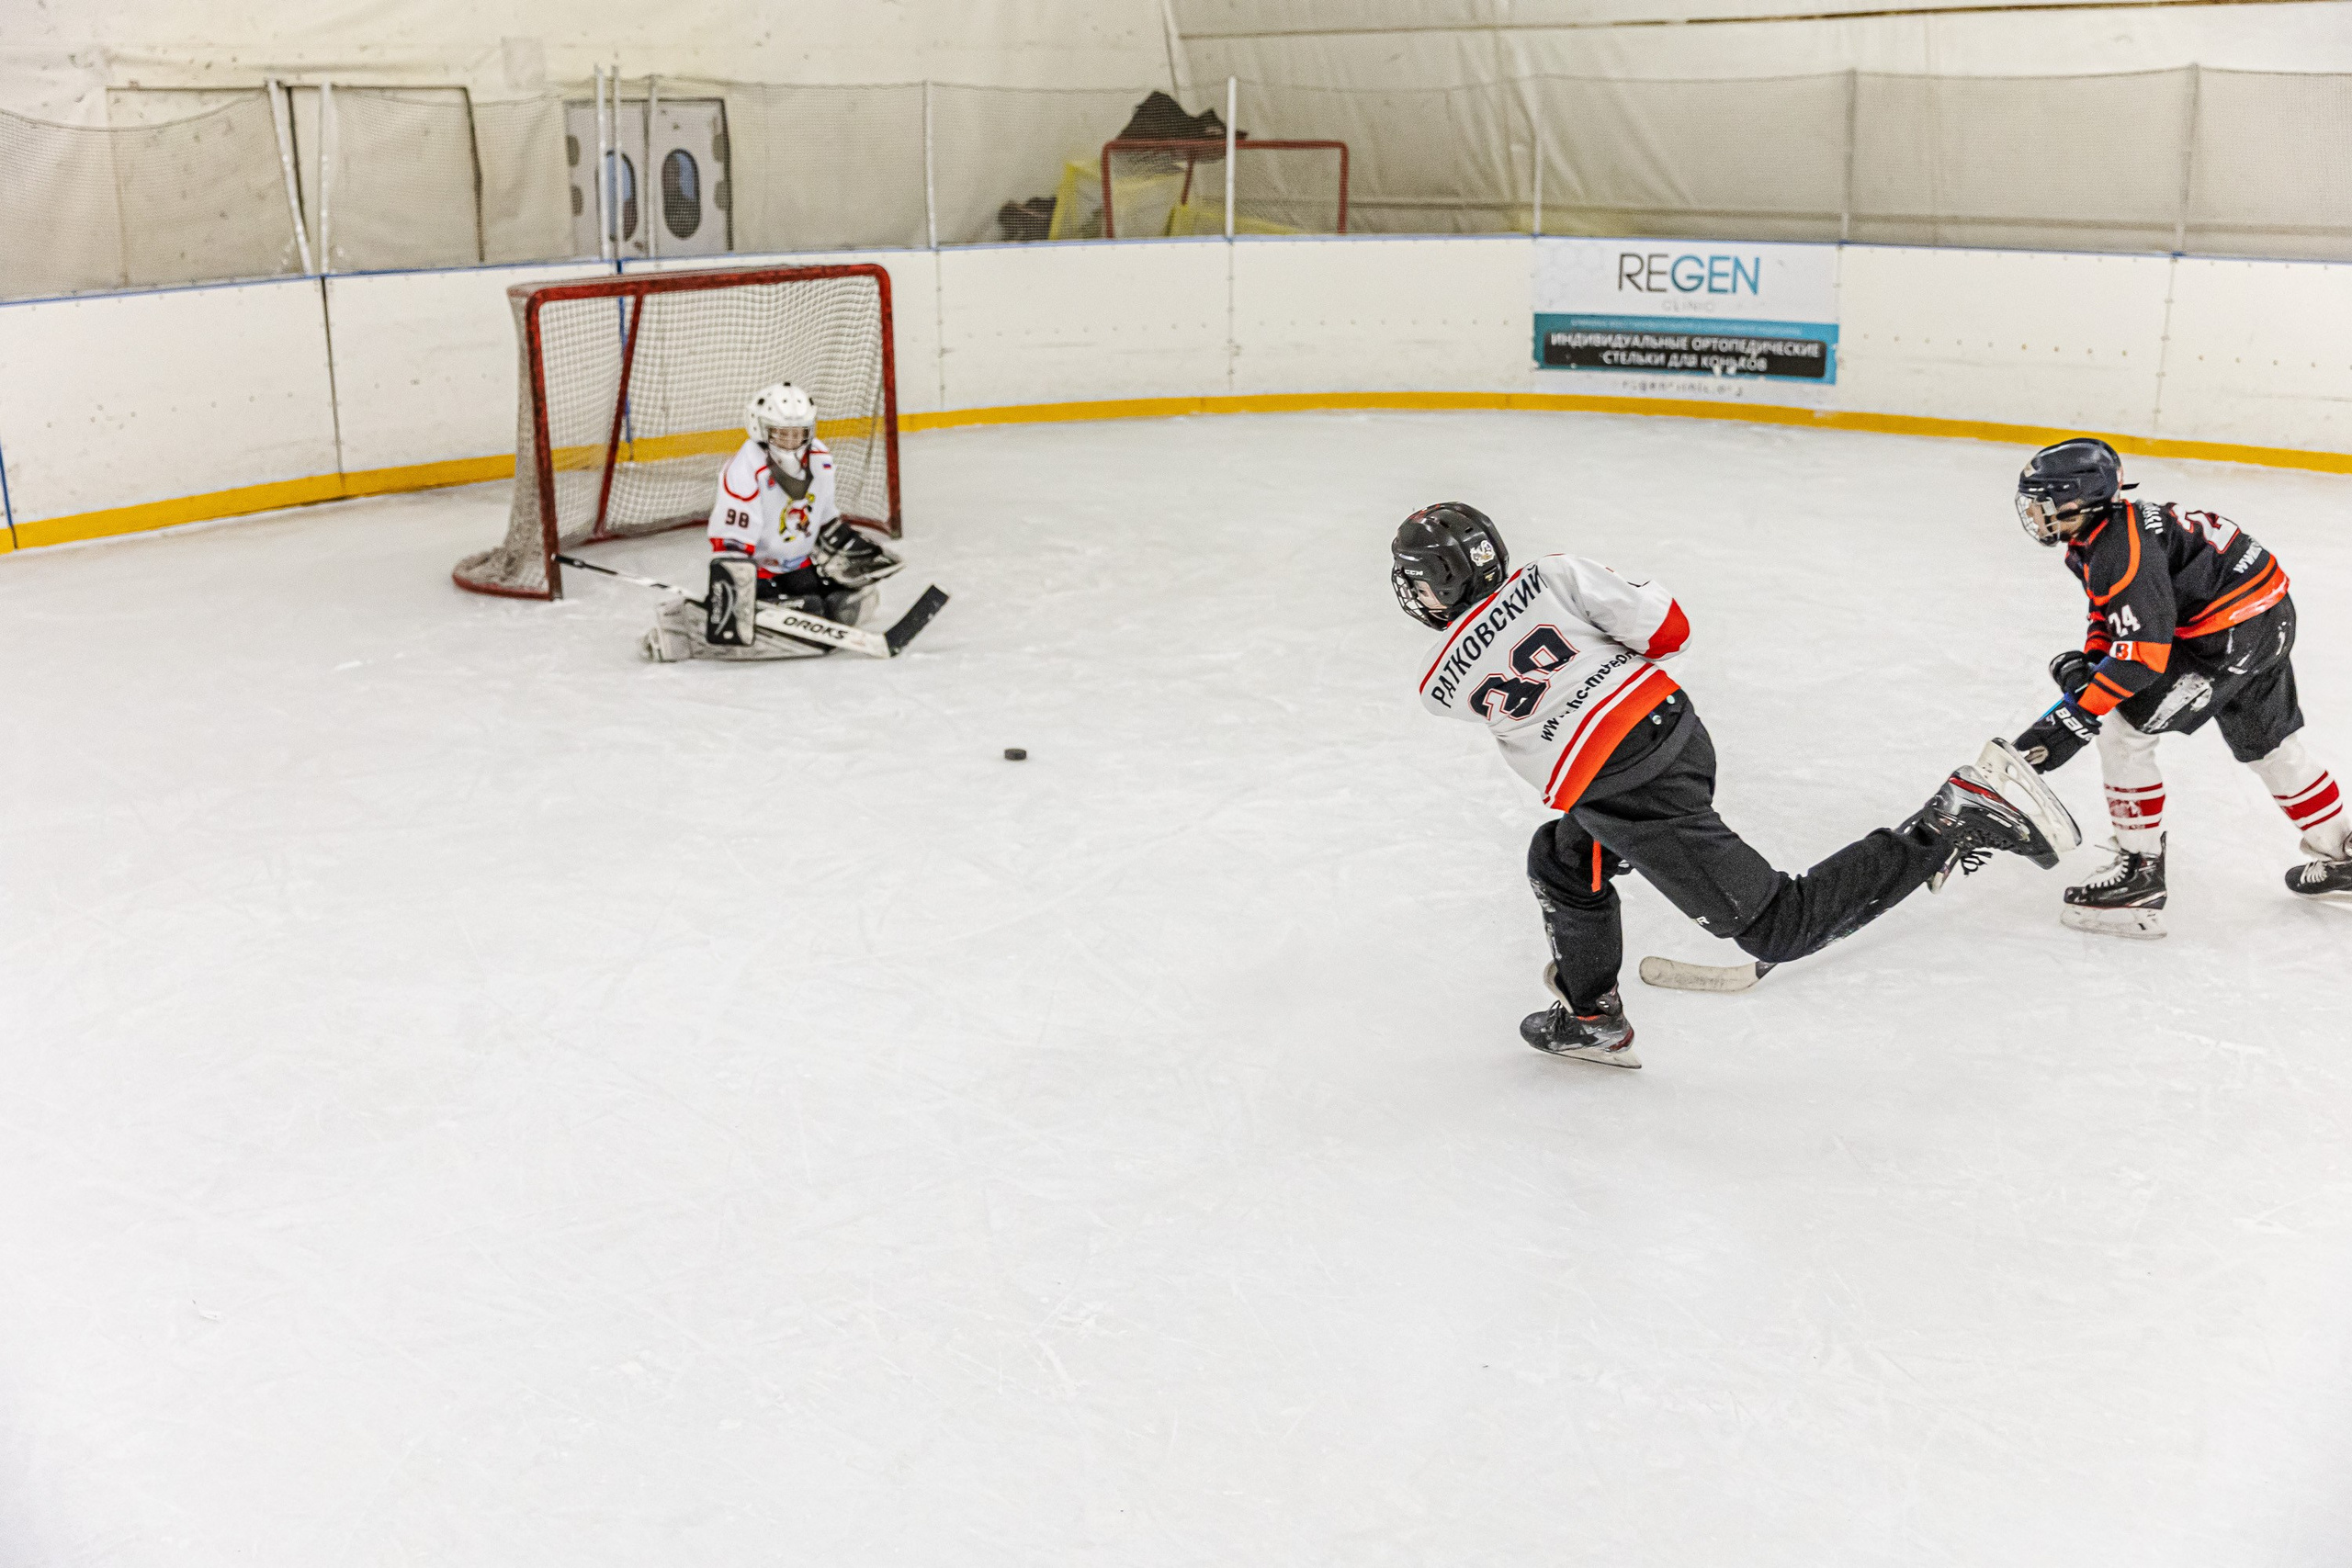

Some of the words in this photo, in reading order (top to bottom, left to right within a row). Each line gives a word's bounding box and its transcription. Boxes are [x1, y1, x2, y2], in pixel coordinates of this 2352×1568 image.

[1618, 253, 1760, 296] REGEN
[1551, 332, 1689, 351] ИНДИВИДУАЛЬНЫЕ
[1690, 336, 1821, 358] ОРТОПЕДИЧЕСКИЕ
[1601, 350, 1667, 366] СТЕЛЬКИ
[1668, 352, 1698, 368] ДЛЯ
[725, 508, 750, 529] 98
[784, 616, 849, 640] OROKS
[2108, 604, 2142, 637] 24
[1430, 564, 1548, 709] РАТКОВСКИЙ
